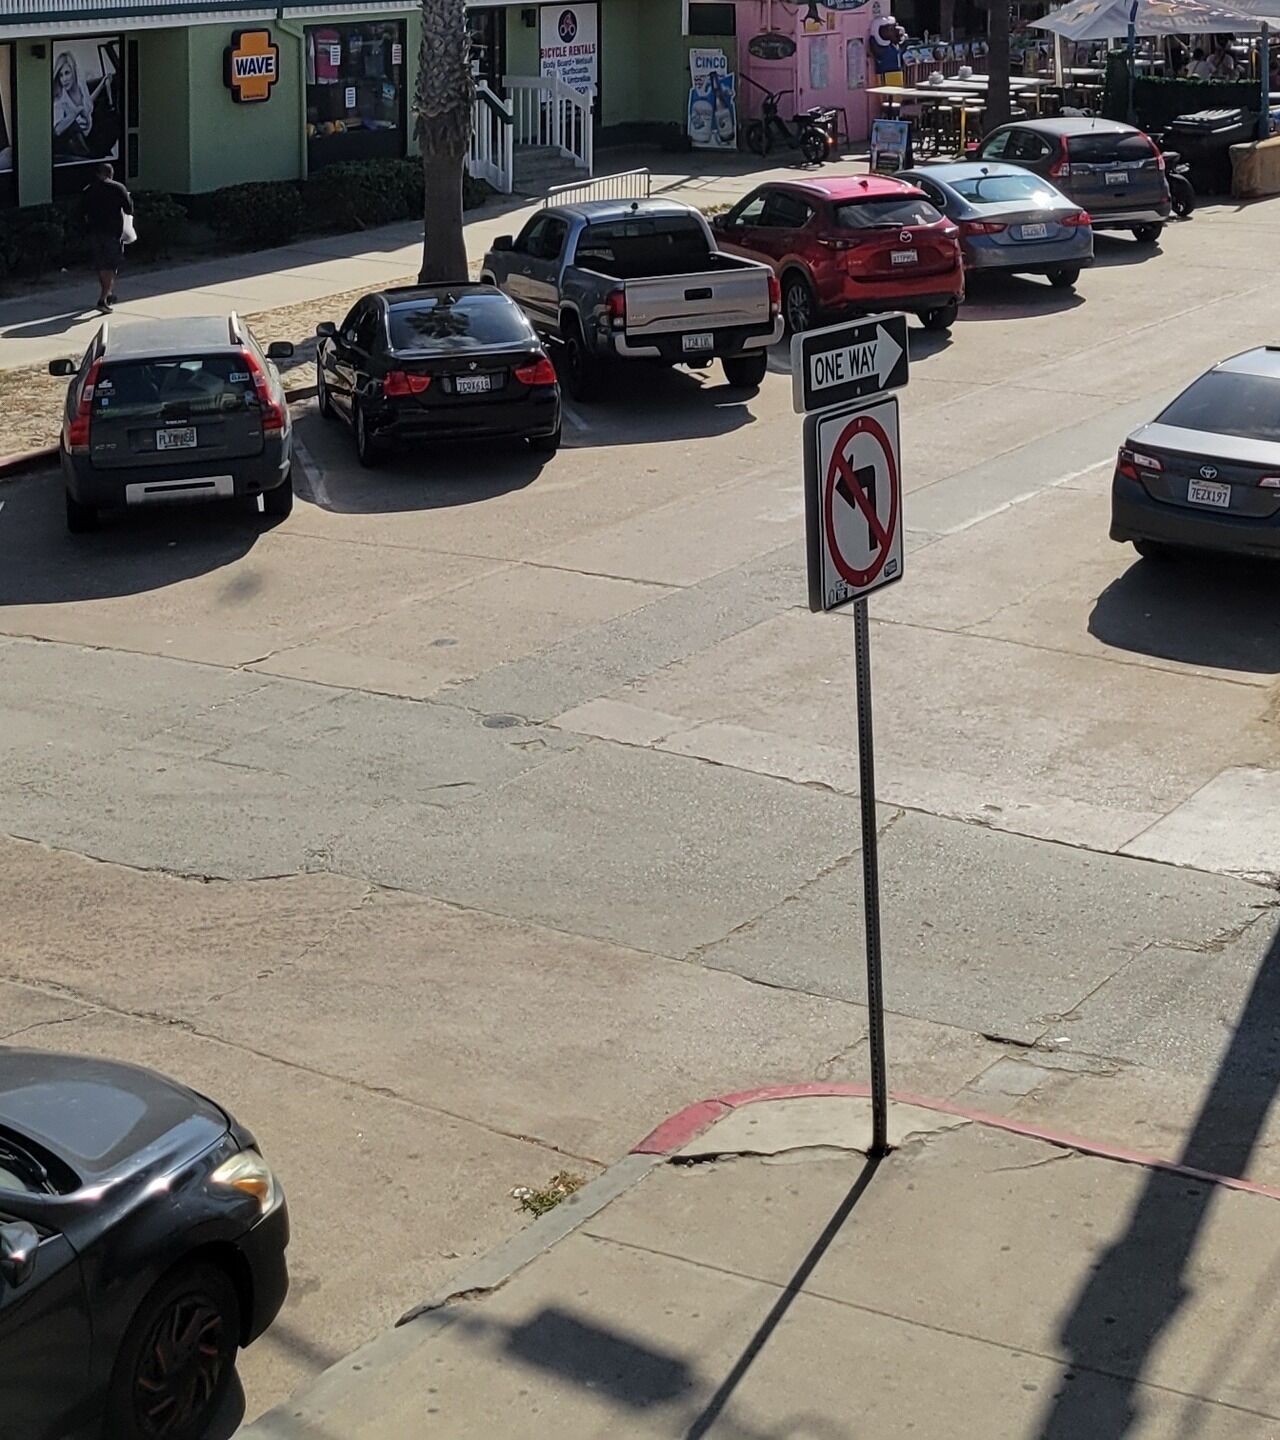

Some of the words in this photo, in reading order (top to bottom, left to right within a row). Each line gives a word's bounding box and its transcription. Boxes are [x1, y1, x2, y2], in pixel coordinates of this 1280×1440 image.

[1174, 14, 1211, 27] Bull
[540, 46, 567, 59] BICYCLE
[568, 43, 596, 56] RENTALS
[235, 56, 274, 76] WAVE
[695, 56, 726, 69] CINCO
[815, 352, 844, 386] ONE
[848, 343, 878, 377] WAY
[1191, 487, 1228, 504] 7EZX197
